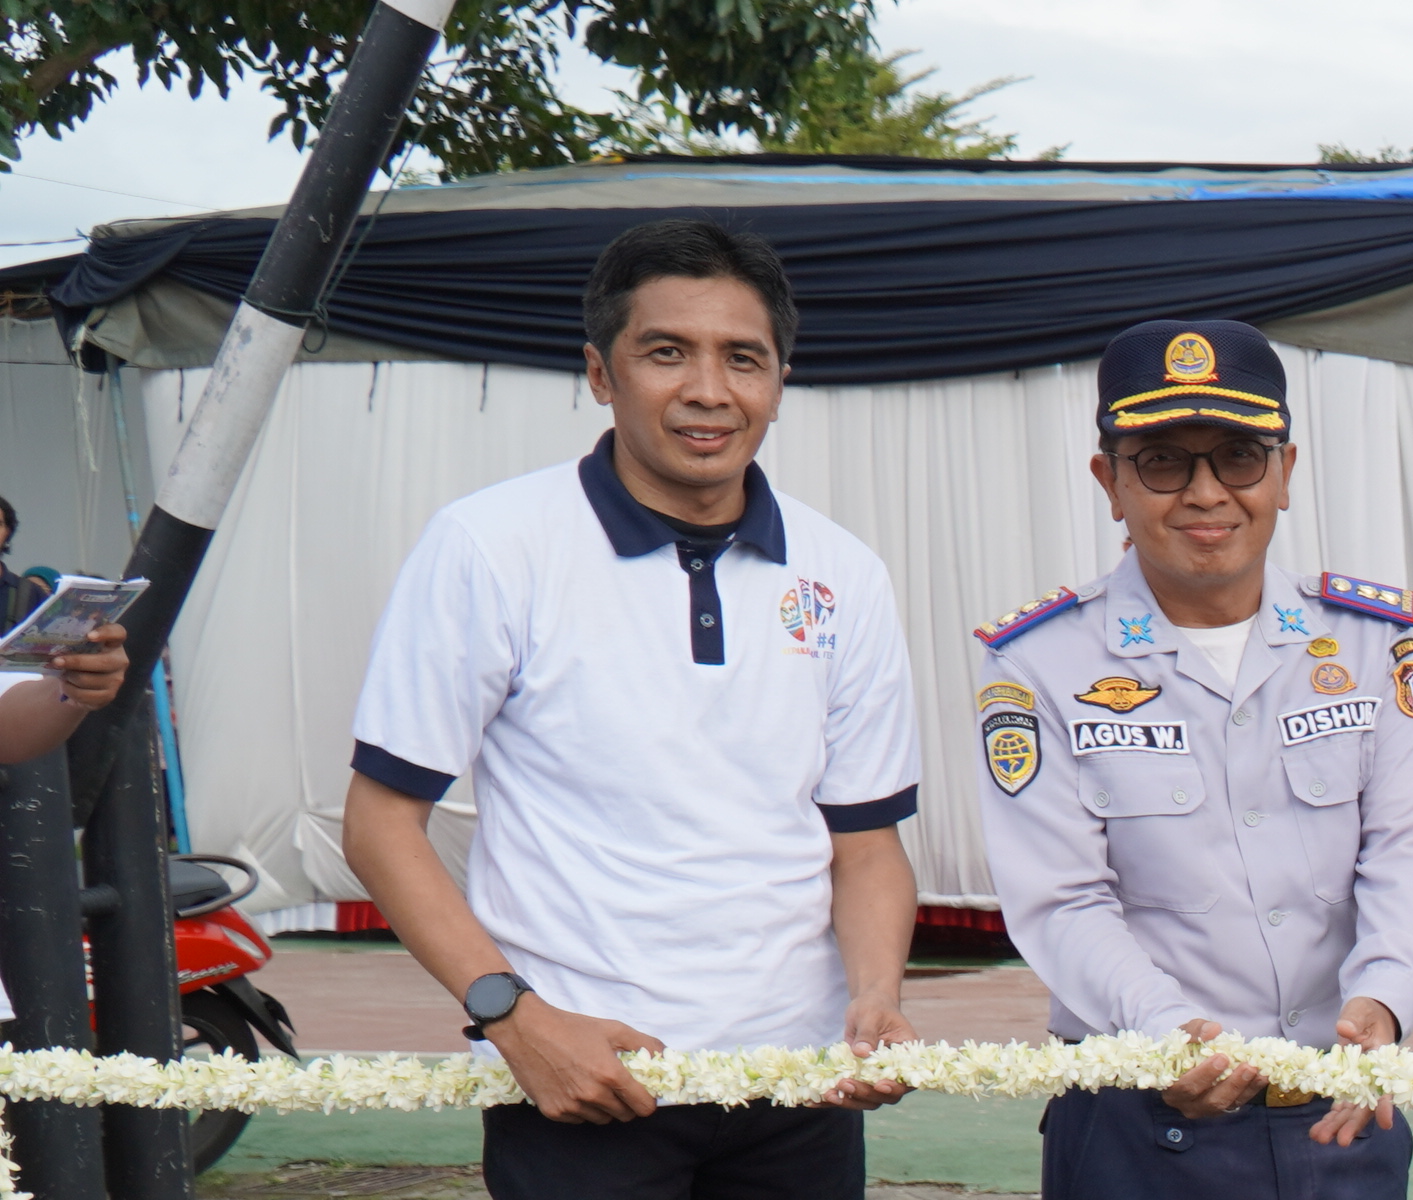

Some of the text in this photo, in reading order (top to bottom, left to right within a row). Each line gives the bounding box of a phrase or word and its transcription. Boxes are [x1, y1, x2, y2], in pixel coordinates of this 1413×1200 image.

[1078, 723, 1183, 749] AGUS W.
[1288, 702, 1374, 739] DISHUB
